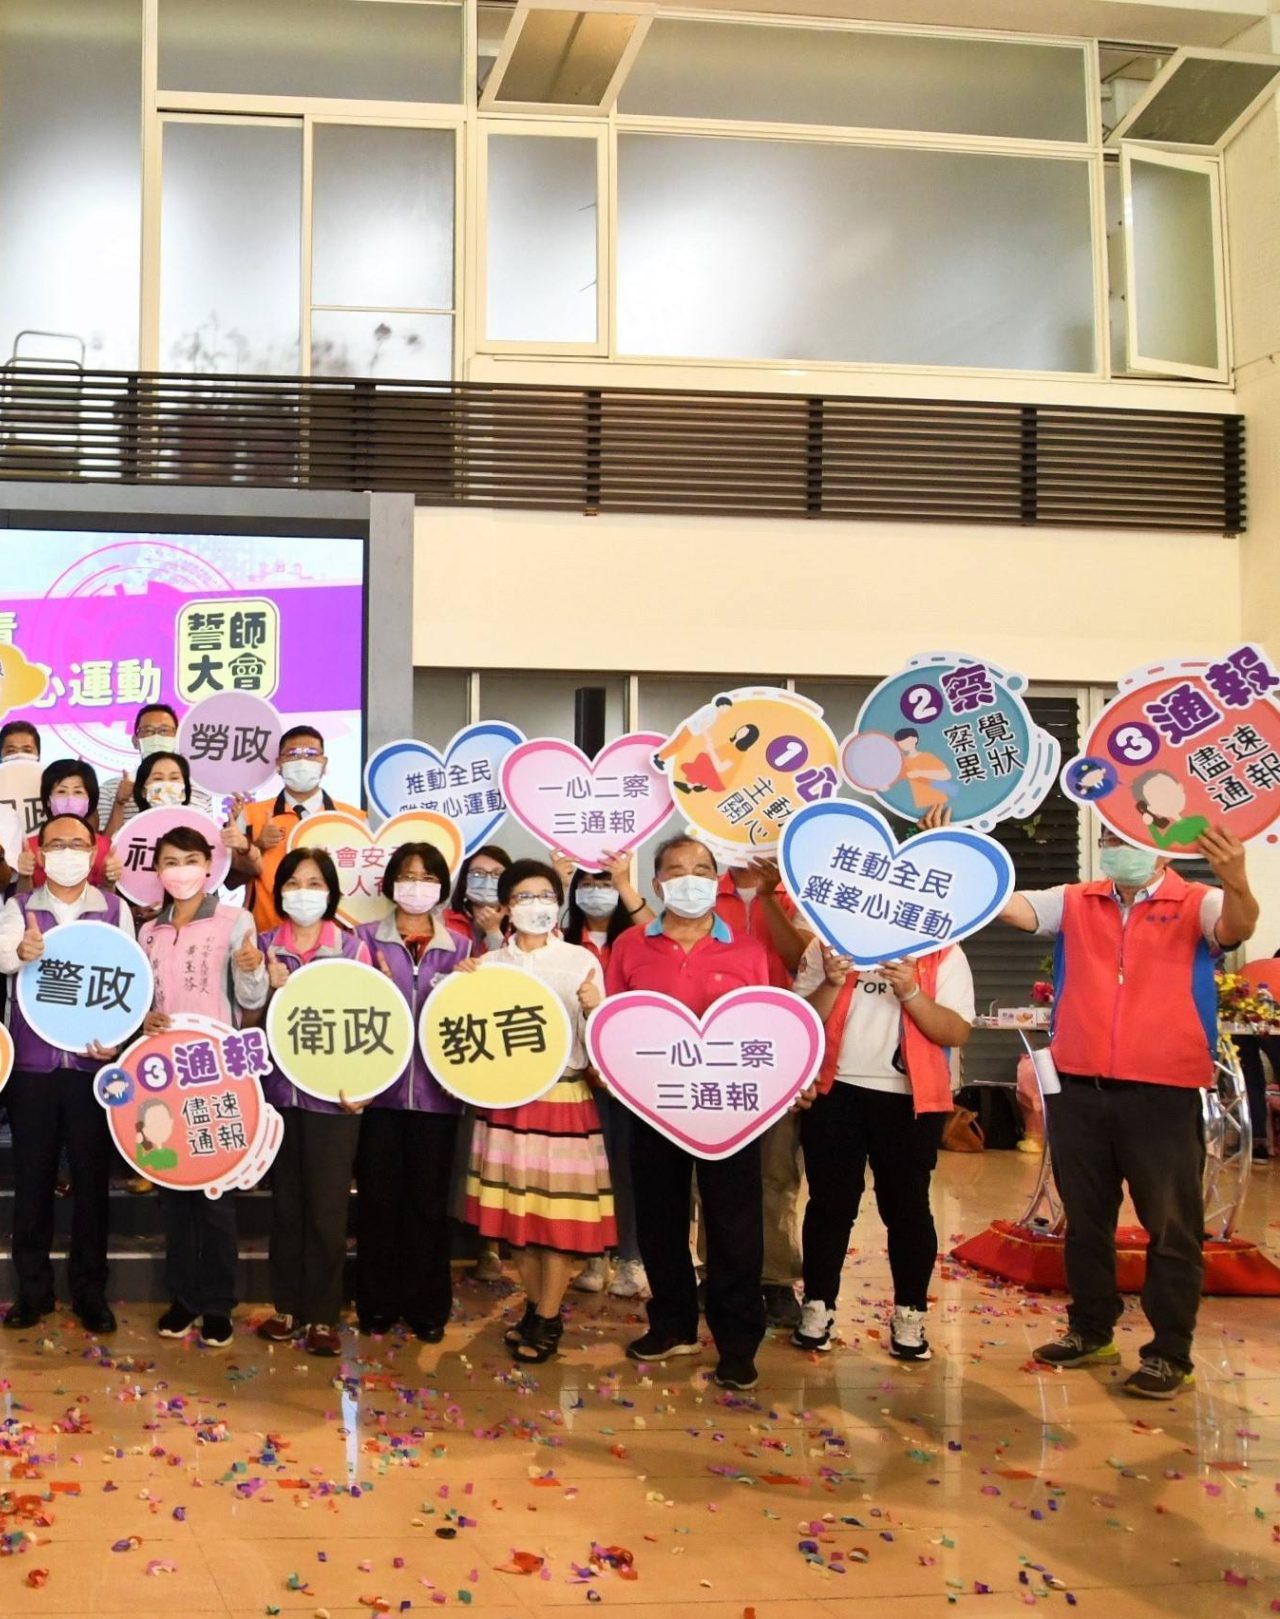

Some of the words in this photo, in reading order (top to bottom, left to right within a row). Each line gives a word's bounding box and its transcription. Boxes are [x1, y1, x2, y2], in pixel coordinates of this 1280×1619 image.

[187, 610, 267, 652] 誓師
[187, 652, 265, 693] 大會
[941, 663, 996, 715] 察
[1147, 645, 1280, 745] 通報
[189, 722, 272, 764] 勞政
[943, 712, 1015, 754] 察覺
[1188, 725, 1268, 783] 儘速
[405, 760, 492, 796] 推動全民
[954, 744, 1025, 784] 異狀
[1208, 753, 1280, 811] 通報
[538, 773, 650, 801] 一心二察
[553, 810, 636, 835] 三通報
[830, 842, 954, 898] 推動全民
[800, 875, 953, 940] 雞婆心運動
[35, 957, 136, 1014] 警政
[287, 1005, 395, 1057] 衛政
[438, 1004, 548, 1065] 教育
[174, 1030, 269, 1088] 通報
[635, 1039, 775, 1069] 一心二察
[183, 1092, 240, 1127] 儘速
[656, 1082, 760, 1113] 三通報
[187, 1125, 248, 1157] 通報
